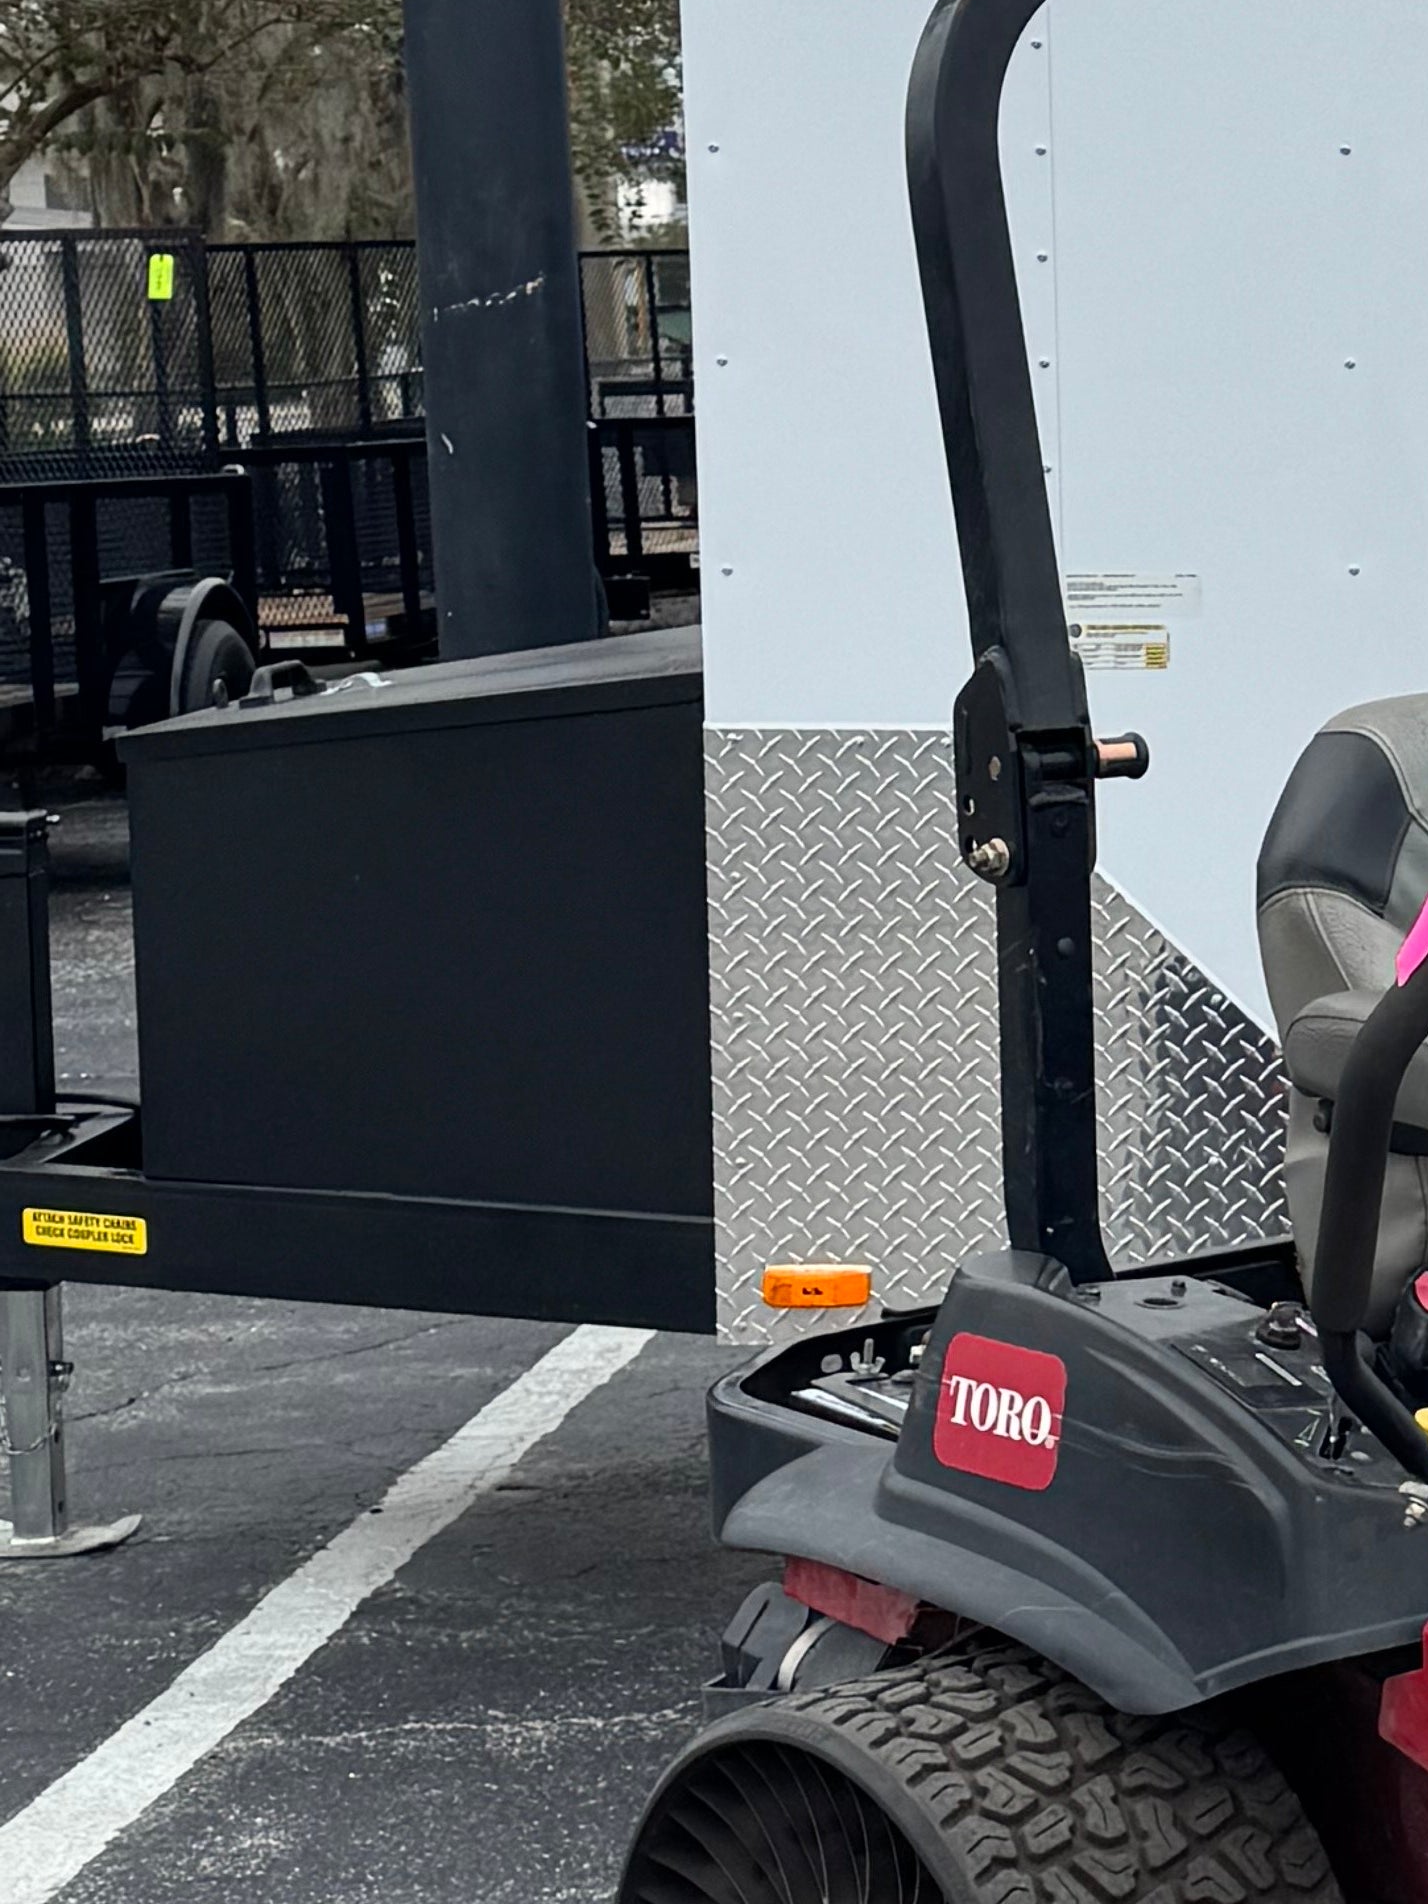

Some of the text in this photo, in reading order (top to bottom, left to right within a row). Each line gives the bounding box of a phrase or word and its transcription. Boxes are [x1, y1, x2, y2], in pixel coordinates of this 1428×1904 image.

[33, 1212, 137, 1231] ATTACH SAFETY CHAINS
[36, 1225, 134, 1244] CHECK COUPLER LOCK
